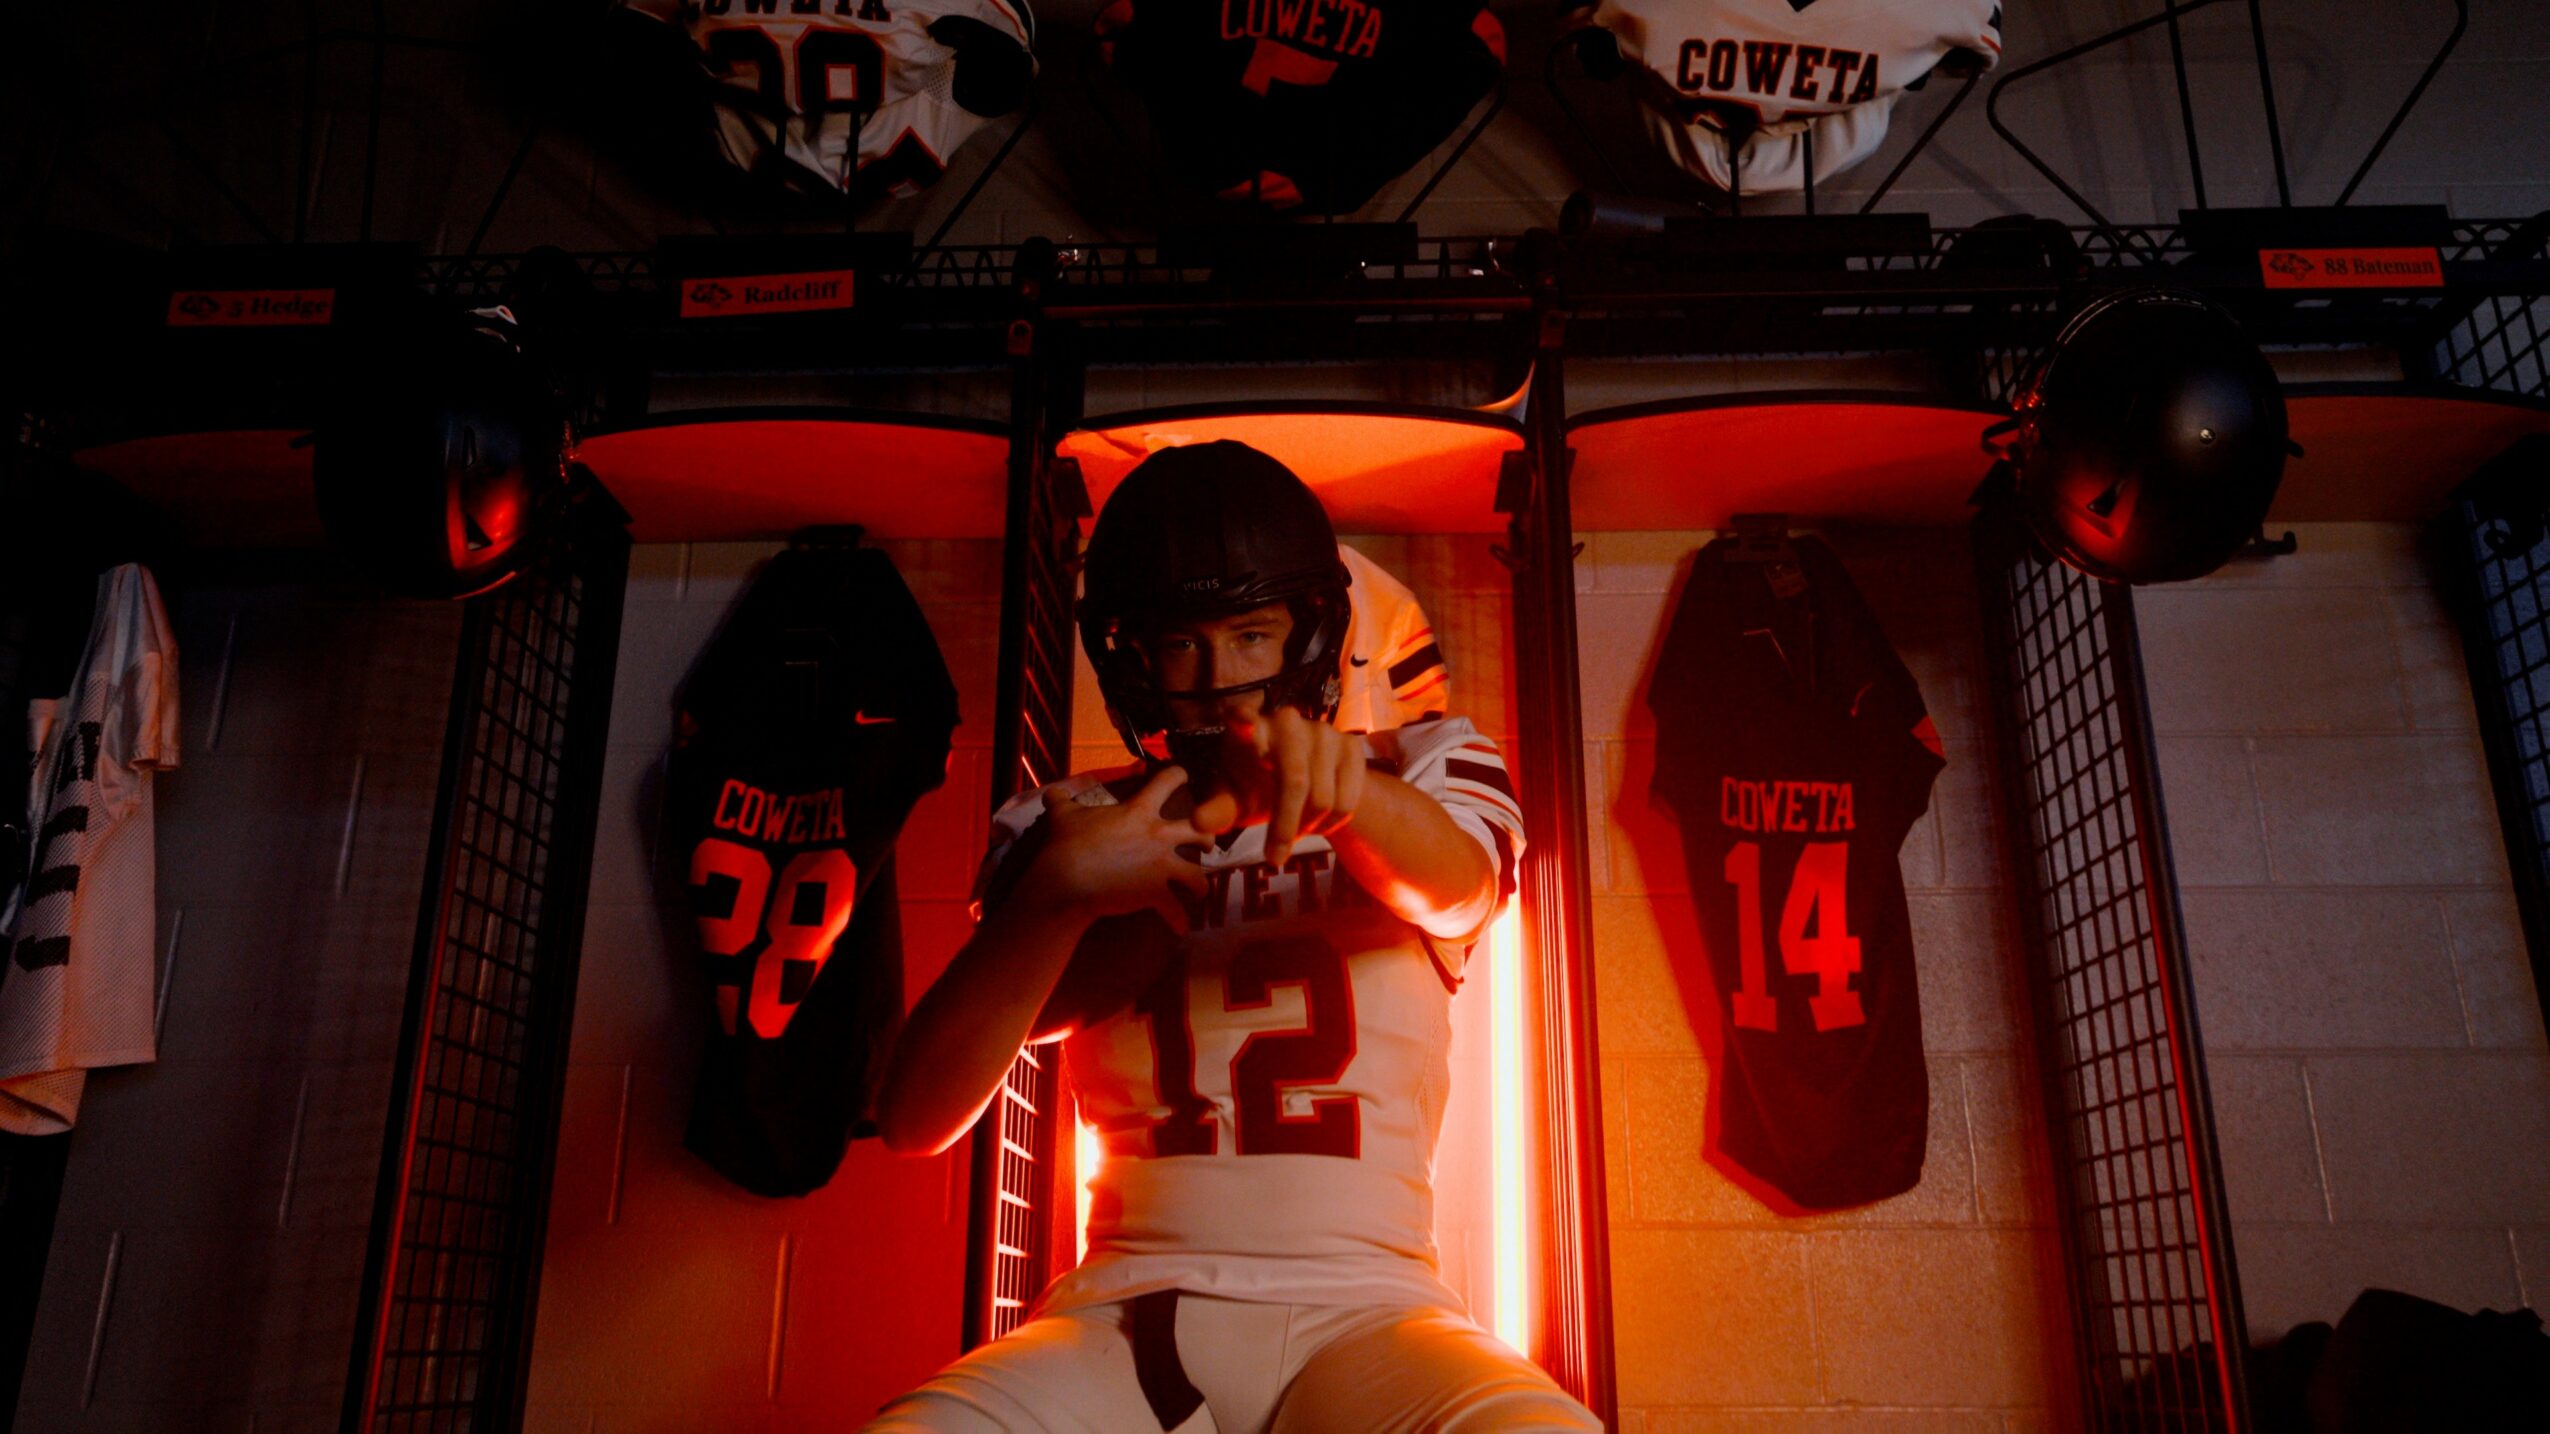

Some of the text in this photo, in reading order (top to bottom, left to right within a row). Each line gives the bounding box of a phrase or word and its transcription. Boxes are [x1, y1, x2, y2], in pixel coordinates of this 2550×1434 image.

[1219, 0, 1383, 59] COWETA
[1677, 39, 1879, 104] COWETA
[744, 280, 841, 304] Radcliff
[2324, 256, 2436, 275] 88 Bateman
[712, 778, 848, 845] COWETA
[1719, 776, 1856, 833] COWETA
[1168, 850, 1335, 930] WET
[1724, 841, 1867, 1033] 14
[1132, 936, 1361, 1160] 12
